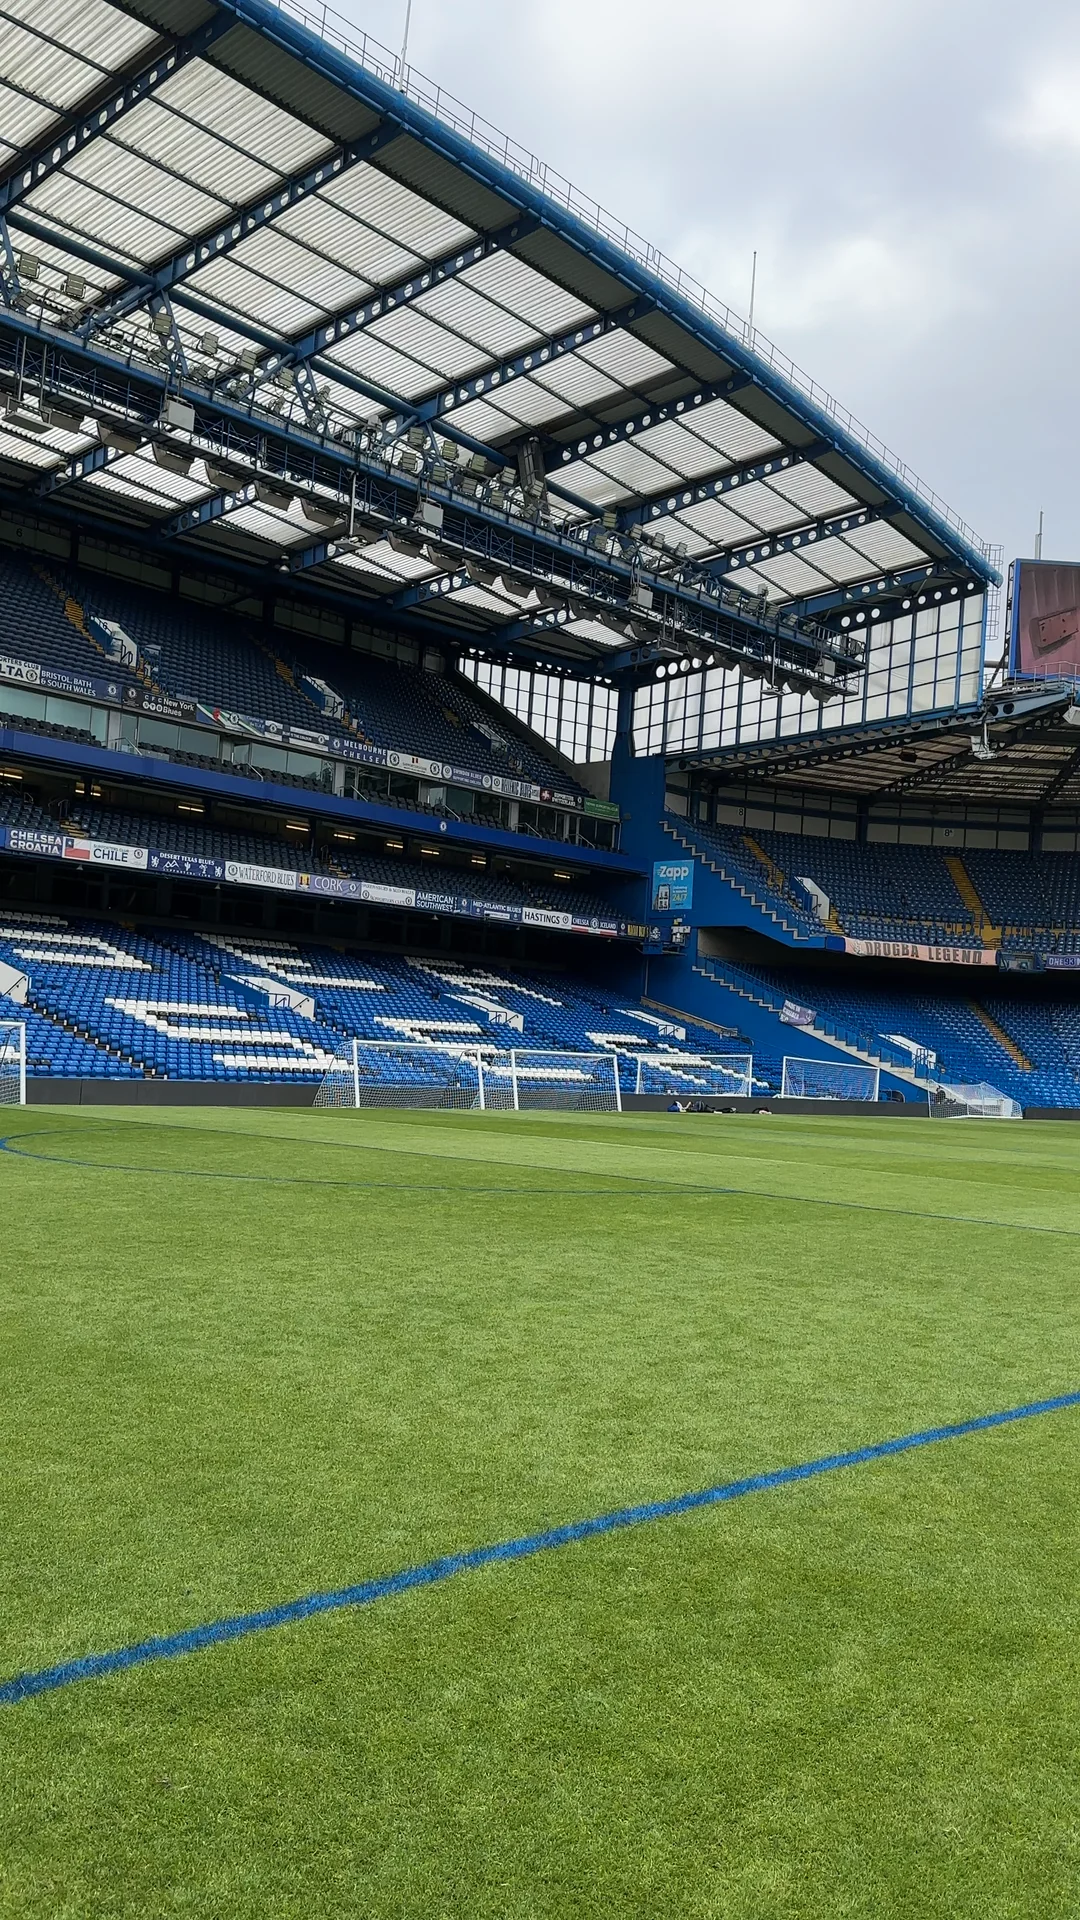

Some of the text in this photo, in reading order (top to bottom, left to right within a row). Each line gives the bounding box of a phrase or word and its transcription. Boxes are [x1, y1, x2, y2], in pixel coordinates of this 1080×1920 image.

[23, 661, 39, 670] CLUB
[40, 678, 96, 697] & SOUTH WALES
[73, 678, 92, 689] BATH
[163, 698, 178, 708] New
[179, 701, 195, 712] York
[163, 705, 182, 717] Blues
[343, 740, 387, 756] MELBOURNE
[343, 749, 387, 766] CHELSEA
[738, 808, 744, 816] 8
[10, 829, 62, 846] CHELSEA
[9, 839, 60, 855] CROATIA
[93, 848, 128, 863] CHILE
[160, 852, 215, 866] DESERT TEXAS BLUES
[239, 866, 295, 887] WATERFORD BLUES
[659, 865, 689, 881] Zapp
[314, 876, 344, 892] CORK
[416, 891, 454, 905] AMERICAN
[672, 893, 688, 902] 24/7
[416, 900, 453, 912] SOUTHWEST
[472, 900, 522, 914] MID-ATLANTIC BLUES
[524, 911, 560, 925] HASTINGS
[572, 917, 617, 930] CHELSEA ICELAND
[865, 941, 983, 964] DROGBA LEGEND
